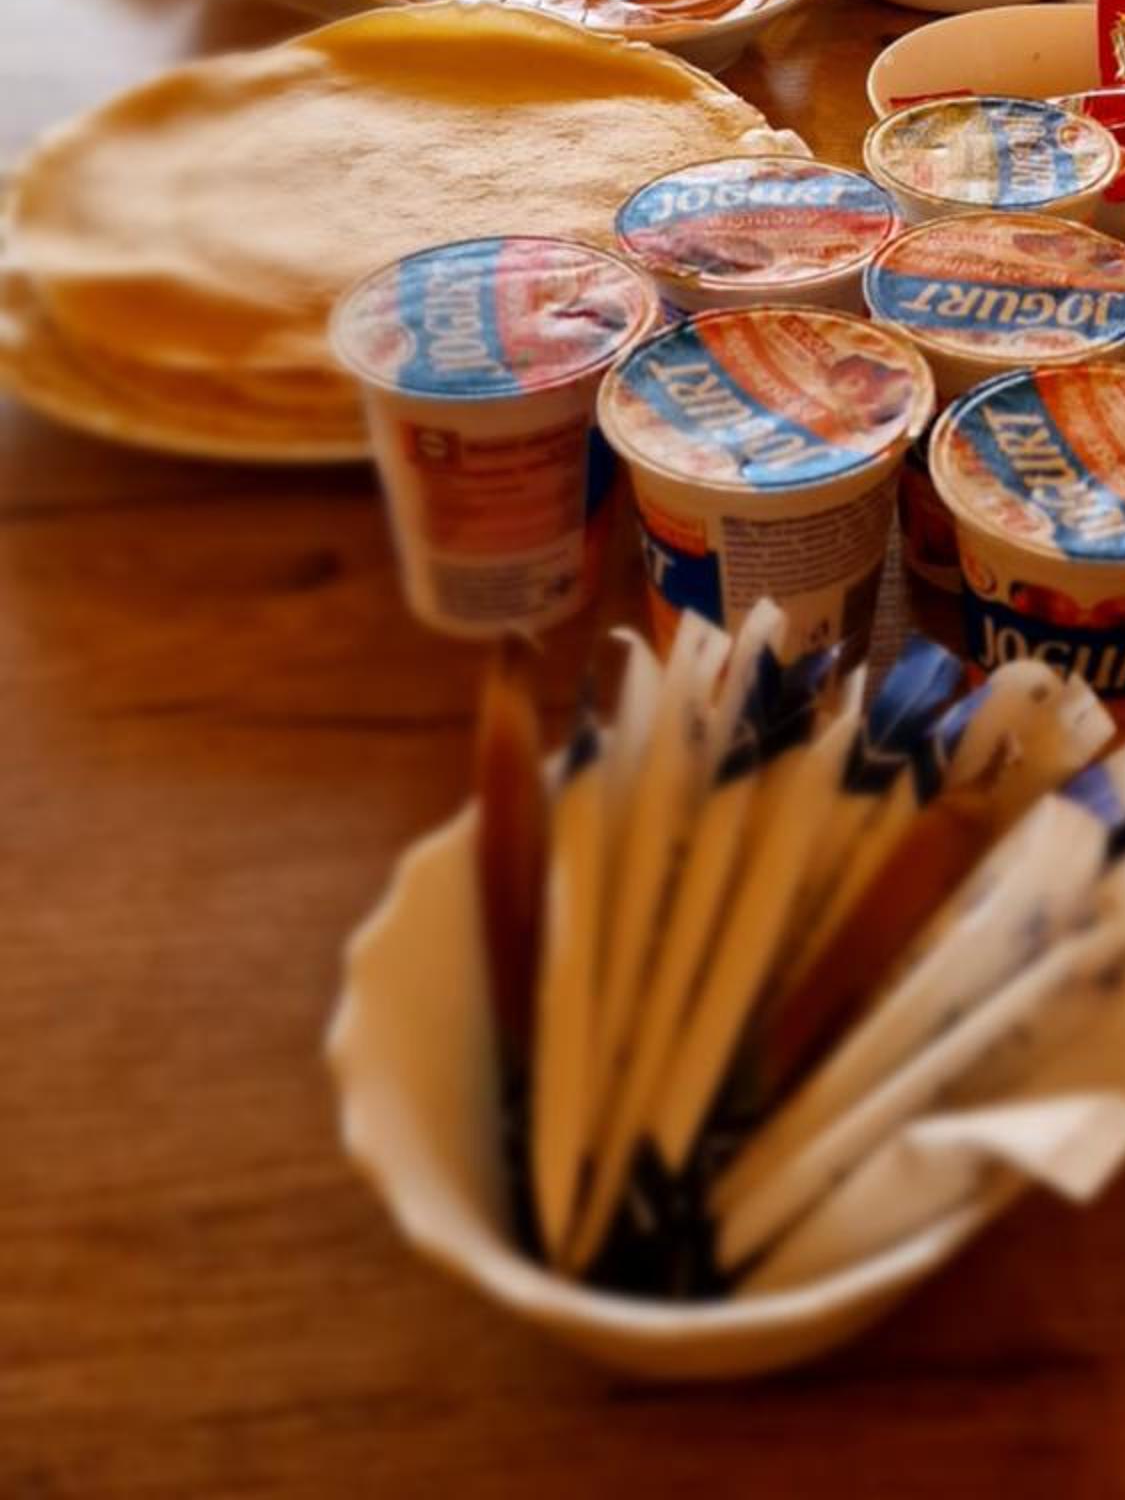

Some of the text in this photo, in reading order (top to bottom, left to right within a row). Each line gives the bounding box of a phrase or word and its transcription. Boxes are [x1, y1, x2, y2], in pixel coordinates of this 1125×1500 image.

[650, 181, 848, 221] JOGURT
[424, 261, 503, 375] JOGURT
[899, 282, 1125, 326] JOGURT
